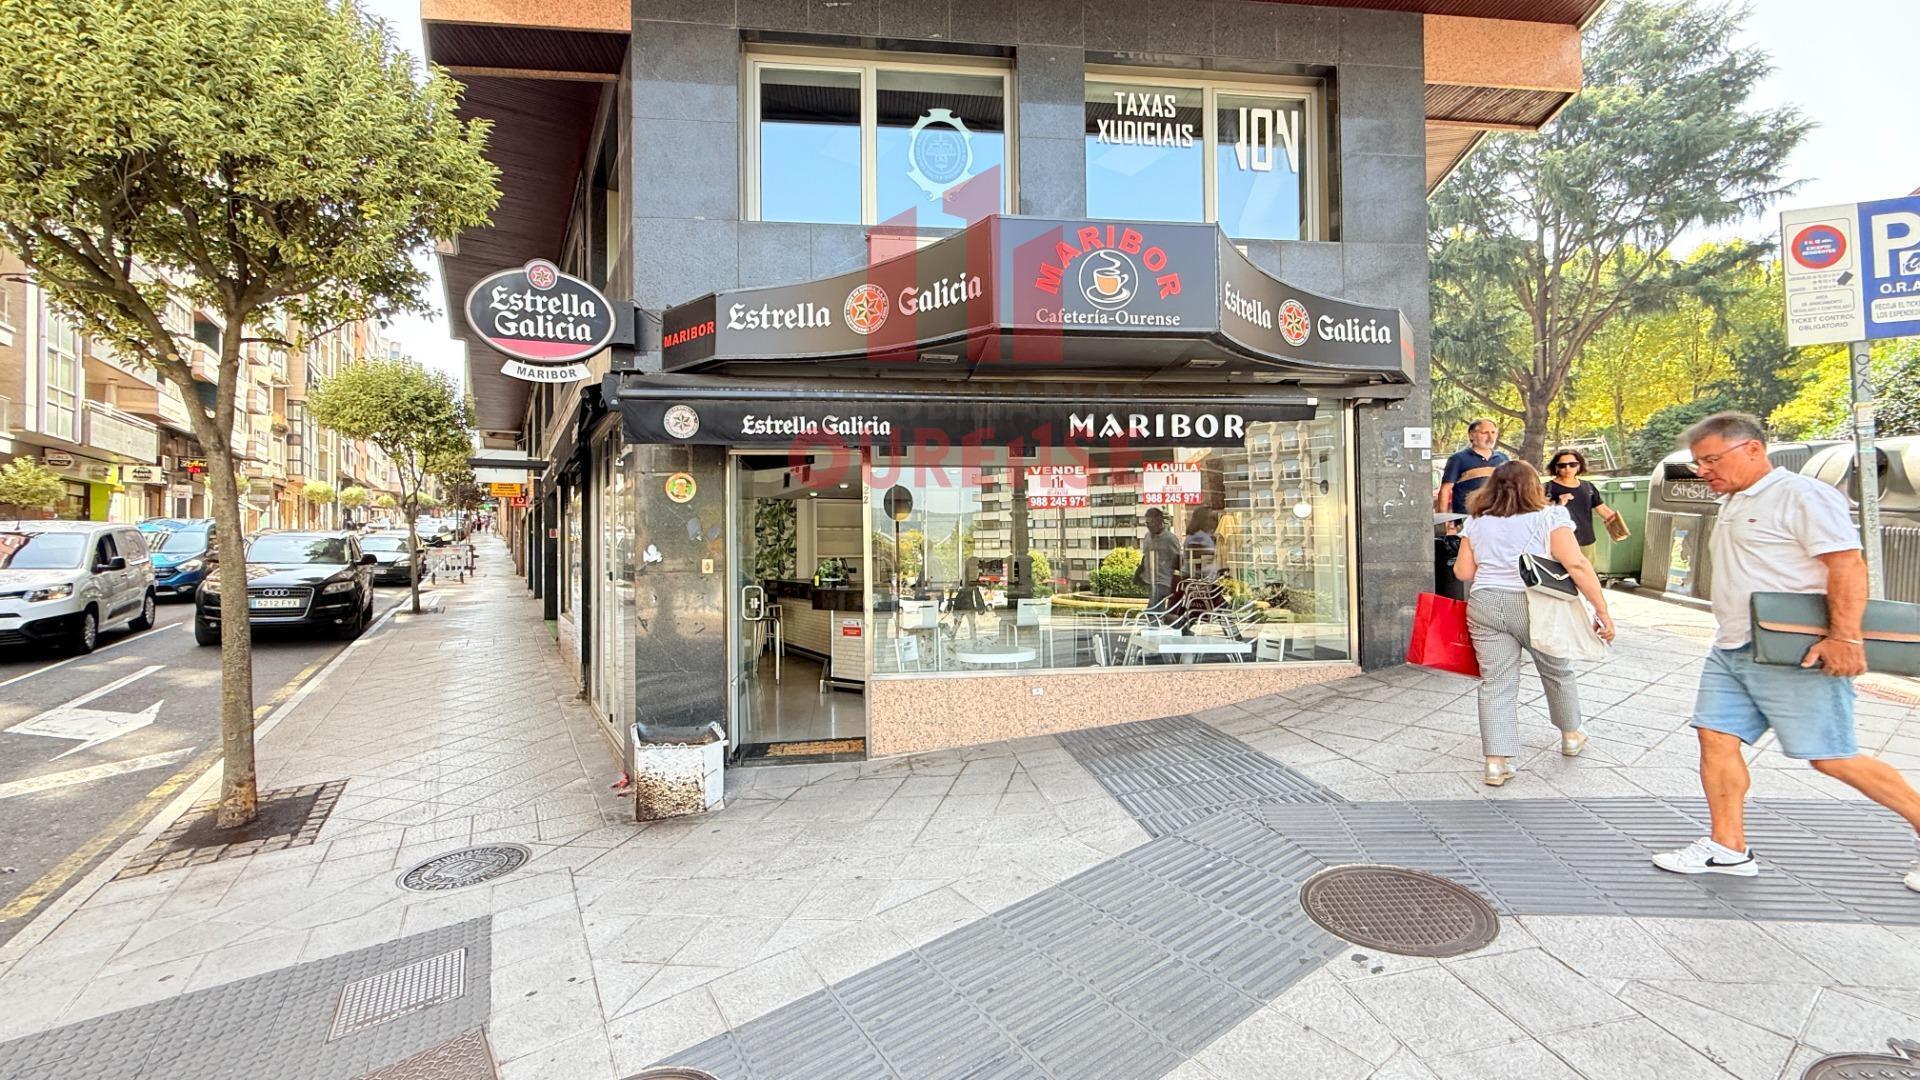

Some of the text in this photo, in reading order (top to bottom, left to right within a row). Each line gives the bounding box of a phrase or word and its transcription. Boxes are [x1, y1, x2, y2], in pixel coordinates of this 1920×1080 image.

[1114, 92, 1176, 118] TAXAS
[1096, 119, 1194, 148] XUDICIAIS
[1871, 212, 1920, 278] P
[1035, 224, 1182, 300] MARIBOR
[488, 286, 597, 319] Estrella
[725, 272, 983, 330] Estrella Galicia
[1225, 281, 1393, 344] Estrella Galicia
[494, 311, 592, 342] Galicia
[1036, 309, 1181, 327] Cafetería-Ourense
[1791, 314, 1855, 325] TICKET CONTROL
[1798, 321, 1848, 331] OBLIGATORIO
[664, 321, 715, 348] MARIBOR
[516, 365, 577, 380] MARIBOR
[741, 414, 892, 436] Estrella Galicia
[1069, 412, 1245, 439] MARIBOR
[1031, 466, 1085, 476] VENDE
[1145, 463, 1198, 472] ALQUILA
[1030, 495, 1086, 507] 988 245 971
[1146, 492, 1200, 504] 988 245 971
[281, 599, 297, 607] FYX
